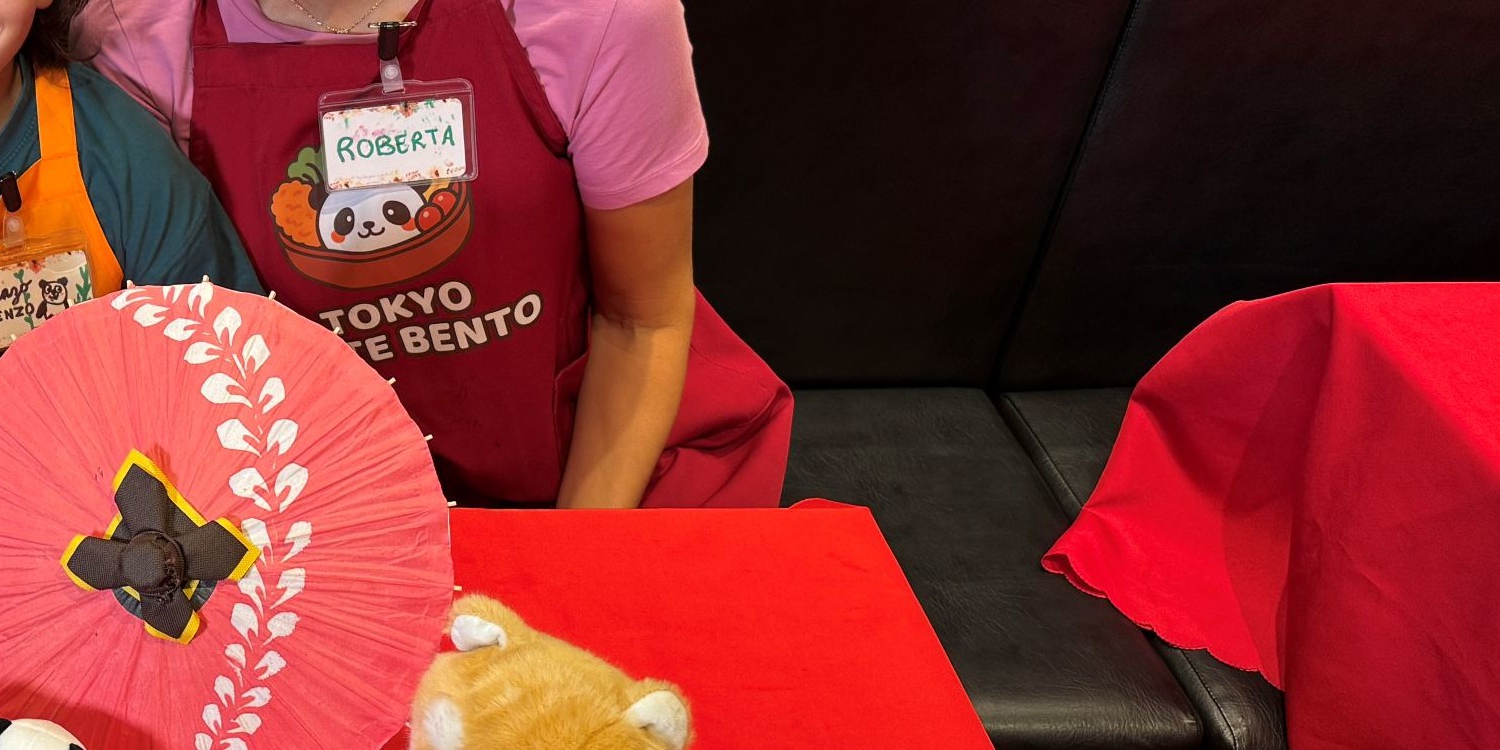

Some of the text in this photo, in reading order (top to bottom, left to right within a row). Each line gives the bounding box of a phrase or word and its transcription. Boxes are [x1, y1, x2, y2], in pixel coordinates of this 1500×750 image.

[336, 124, 456, 163] ROBERTA
[318, 281, 472, 335] TOKYO
[399, 293, 542, 354] BENTO
